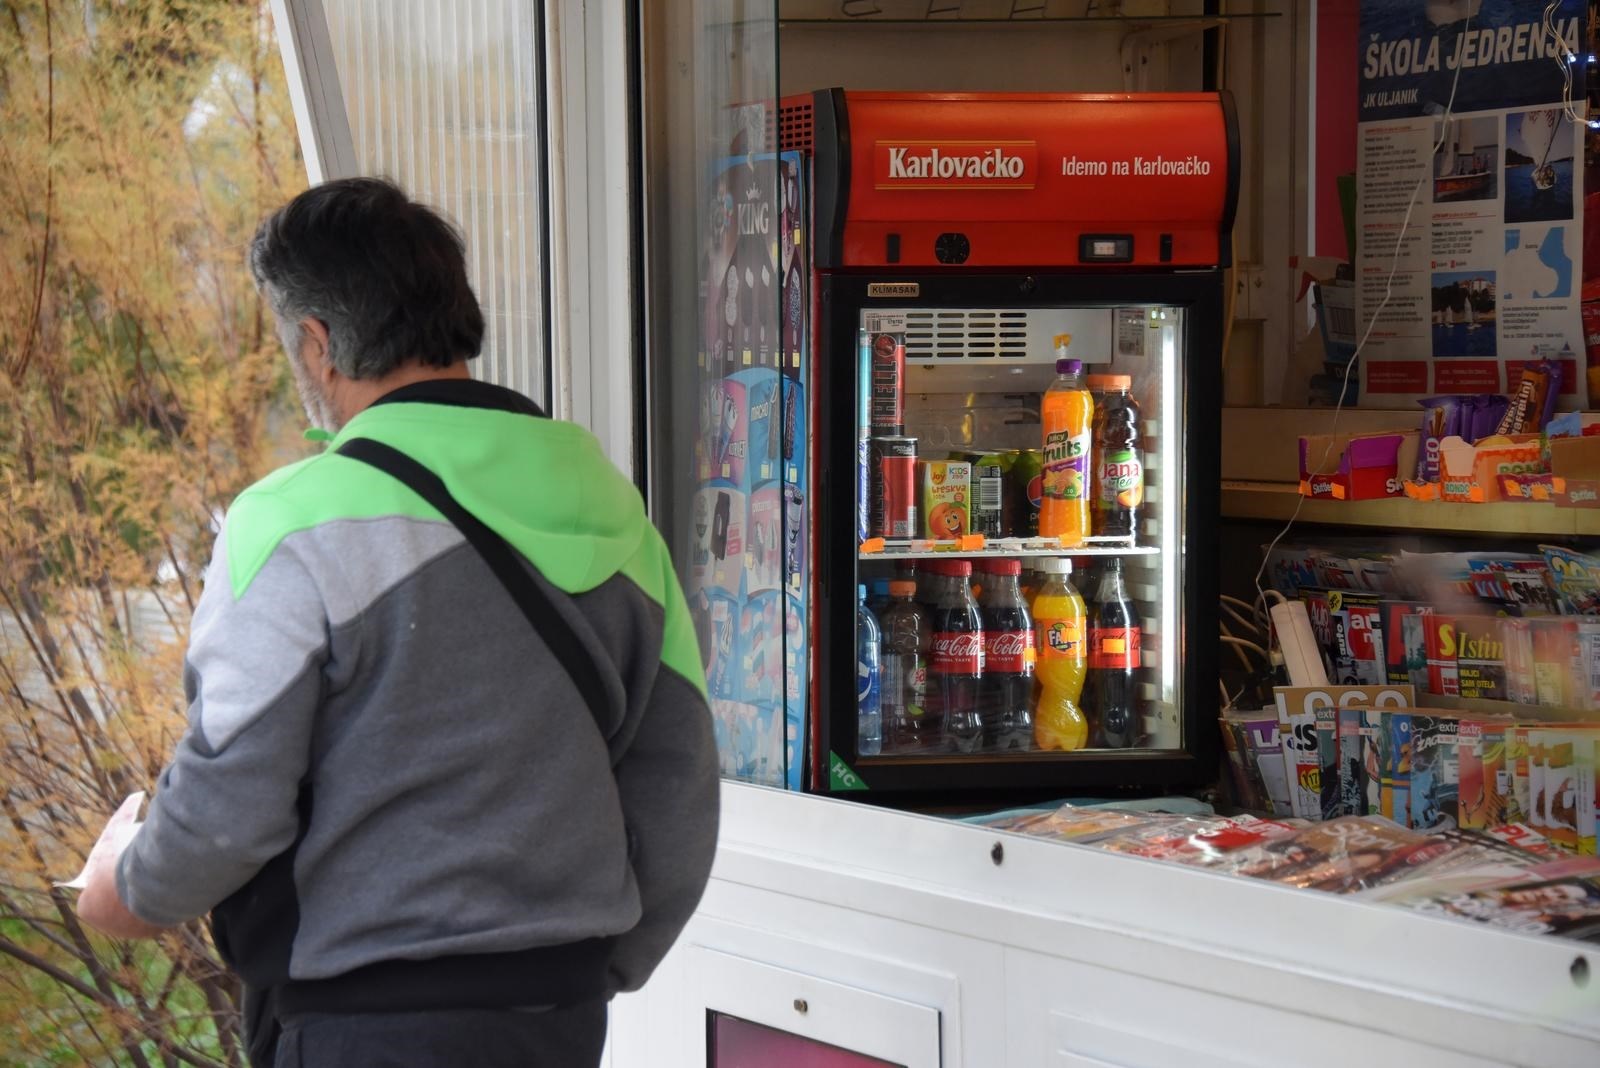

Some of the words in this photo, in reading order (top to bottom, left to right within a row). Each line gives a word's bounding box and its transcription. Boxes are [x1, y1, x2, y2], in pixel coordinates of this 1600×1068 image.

[1363, 33, 1439, 80] ŠKOLA
[1445, 17, 1580, 70] JEDRENJA
[1363, 93, 1377, 108] JK
[1377, 88, 1418, 106] ULJANIK
[888, 147, 1024, 179] Karlovačko
[1062, 157, 1107, 176] Idemo
[1111, 161, 1129, 176] na
[1134, 155, 1210, 176] Karlovačko
[737, 203, 769, 235] KING
[872, 285, 917, 295] KLIMASAN
[873, 361, 897, 416] HELL
[1426, 437, 1440, 472] LEO
[1336, 623, 1347, 657] auto
[832, 762, 856, 787] HC
